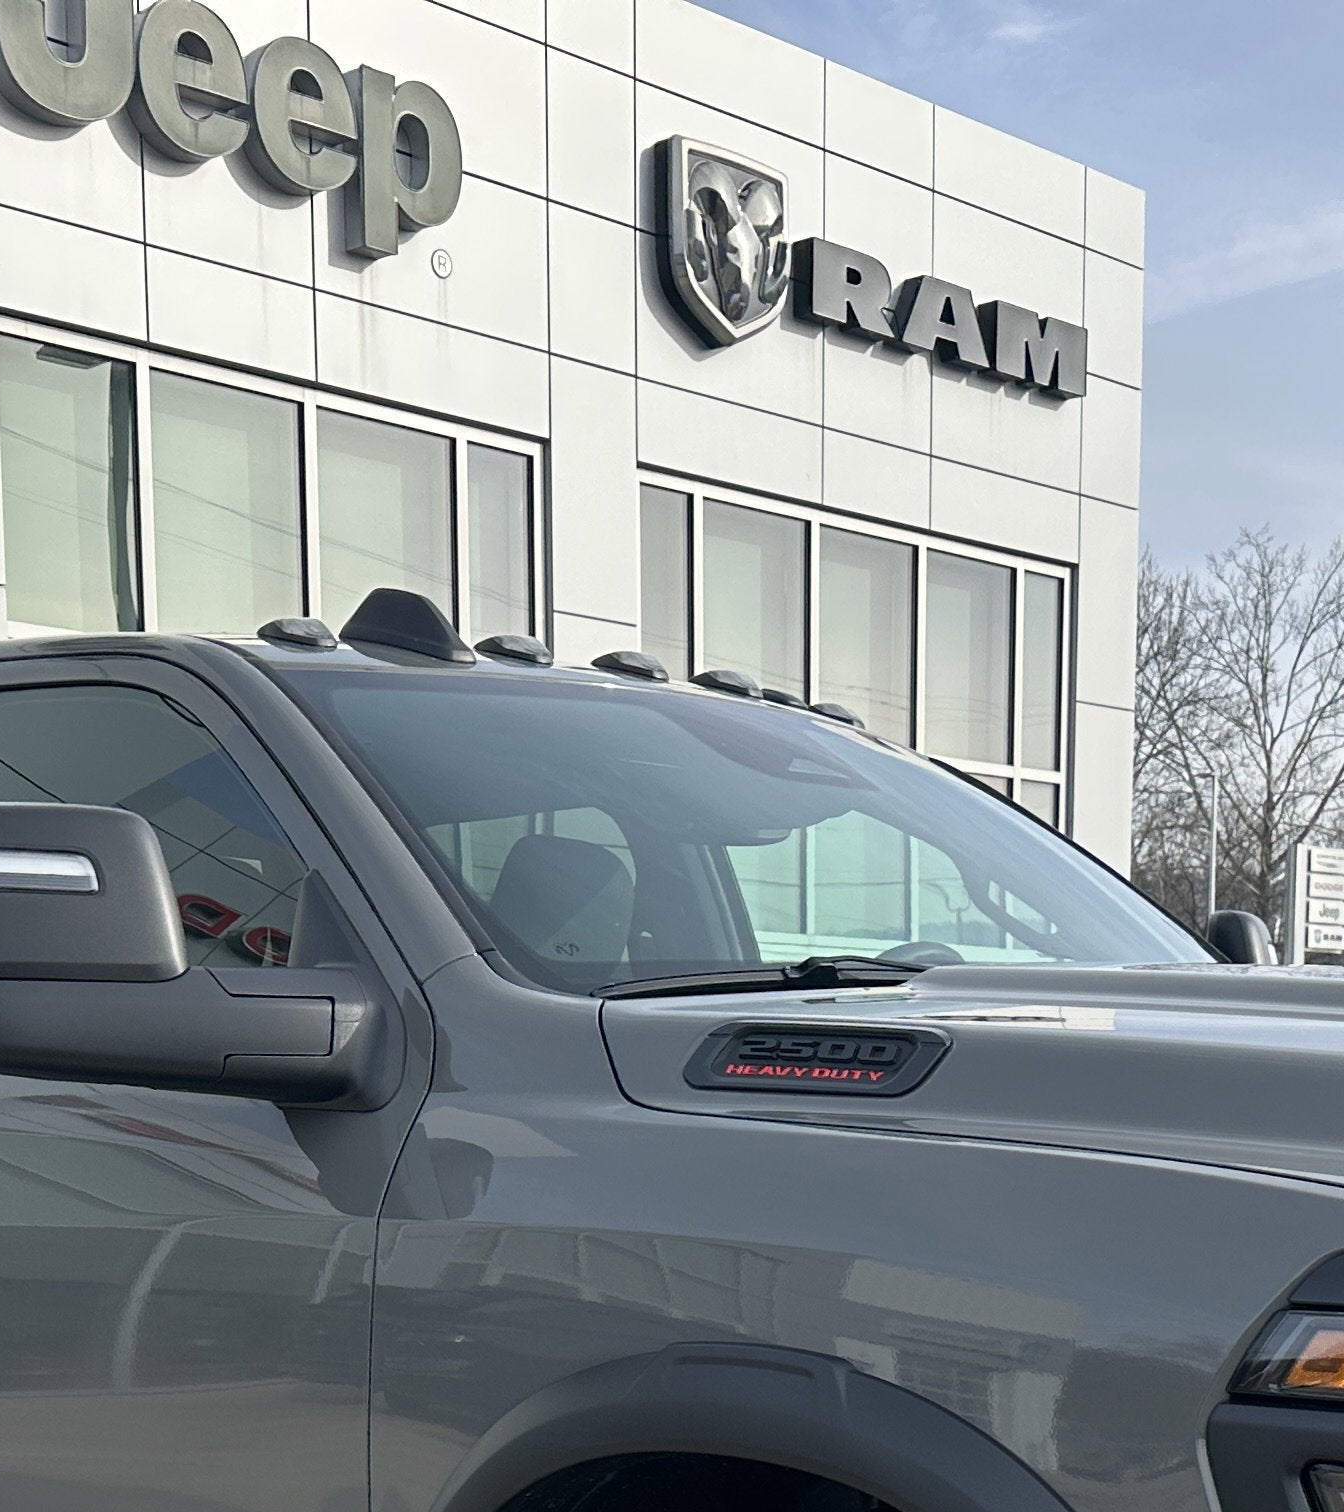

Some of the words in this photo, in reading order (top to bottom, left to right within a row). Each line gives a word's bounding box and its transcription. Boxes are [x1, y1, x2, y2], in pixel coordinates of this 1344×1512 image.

[792, 237, 1087, 398] RAM
[1314, 882, 1344, 892] DODGE
[1319, 902, 1340, 922] Jeep
[1323, 933, 1343, 942] RAM
[739, 1038, 899, 1065] 2500
[725, 1063, 810, 1078] HEAVY
[811, 1067, 886, 1081] DUTY
